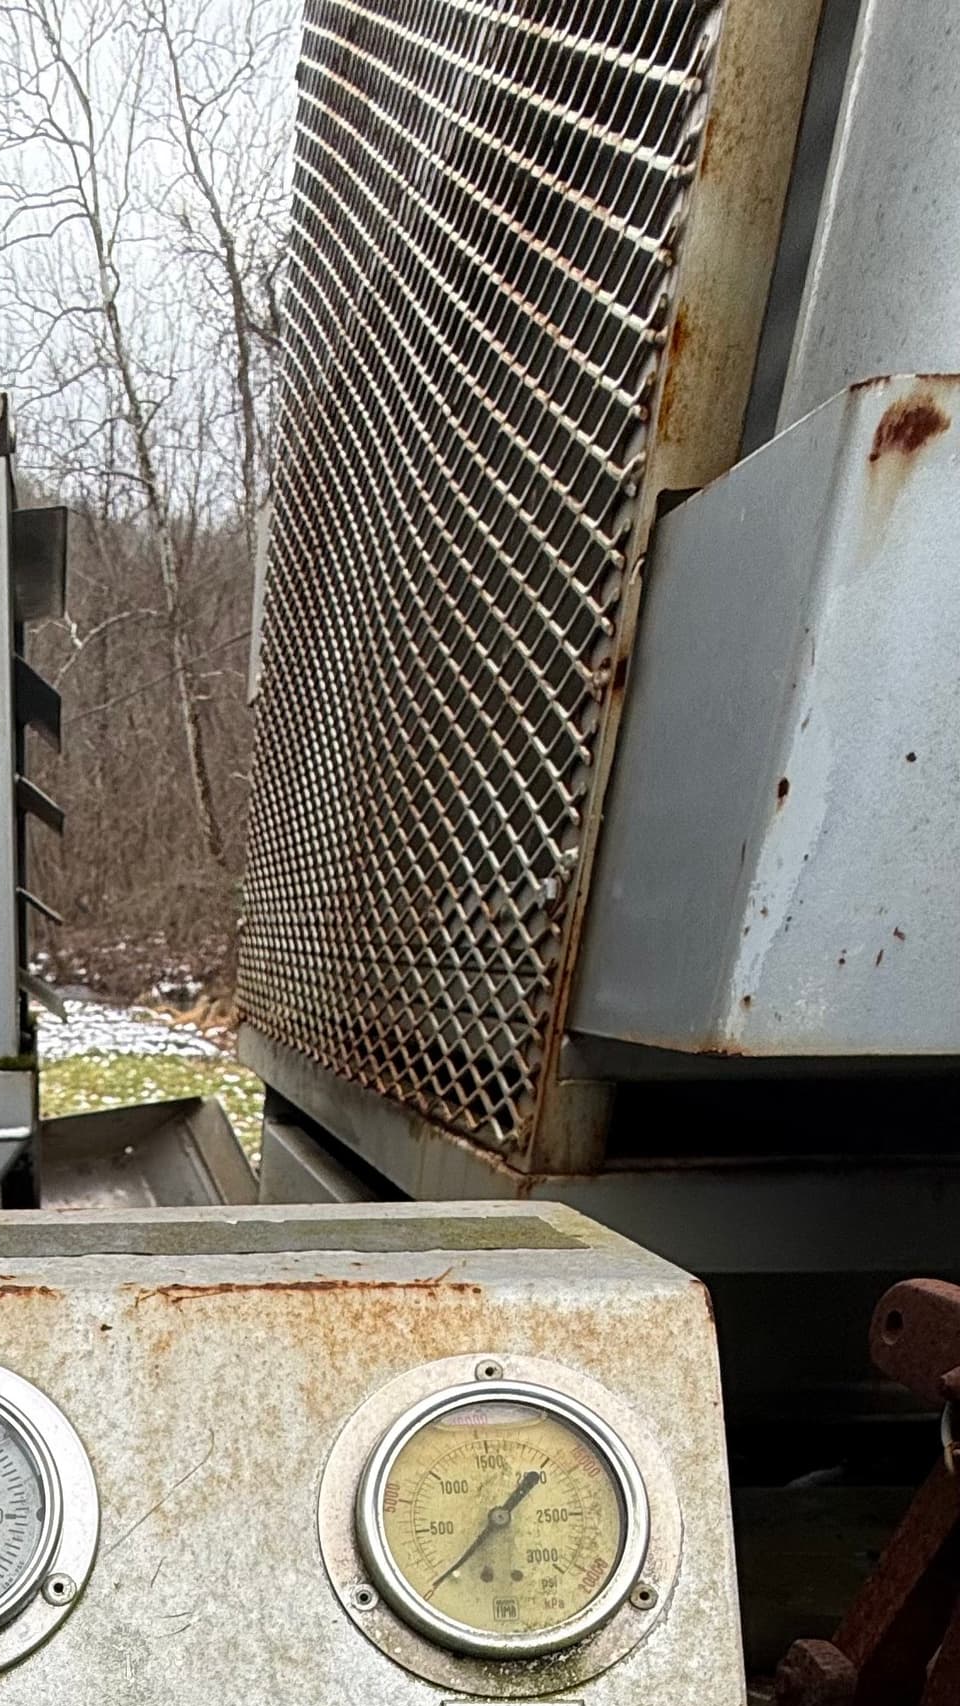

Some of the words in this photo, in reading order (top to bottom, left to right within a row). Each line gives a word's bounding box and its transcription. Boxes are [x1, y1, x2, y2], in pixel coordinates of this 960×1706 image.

[476, 1455, 504, 1470] 1500
[516, 1471, 547, 1485] 20
[440, 1480, 469, 1494] 1000
[384, 1483, 401, 1513] 5000
[536, 1508, 569, 1523] 2500
[430, 1521, 454, 1535] 500
[527, 1548, 558, 1563] 3000
